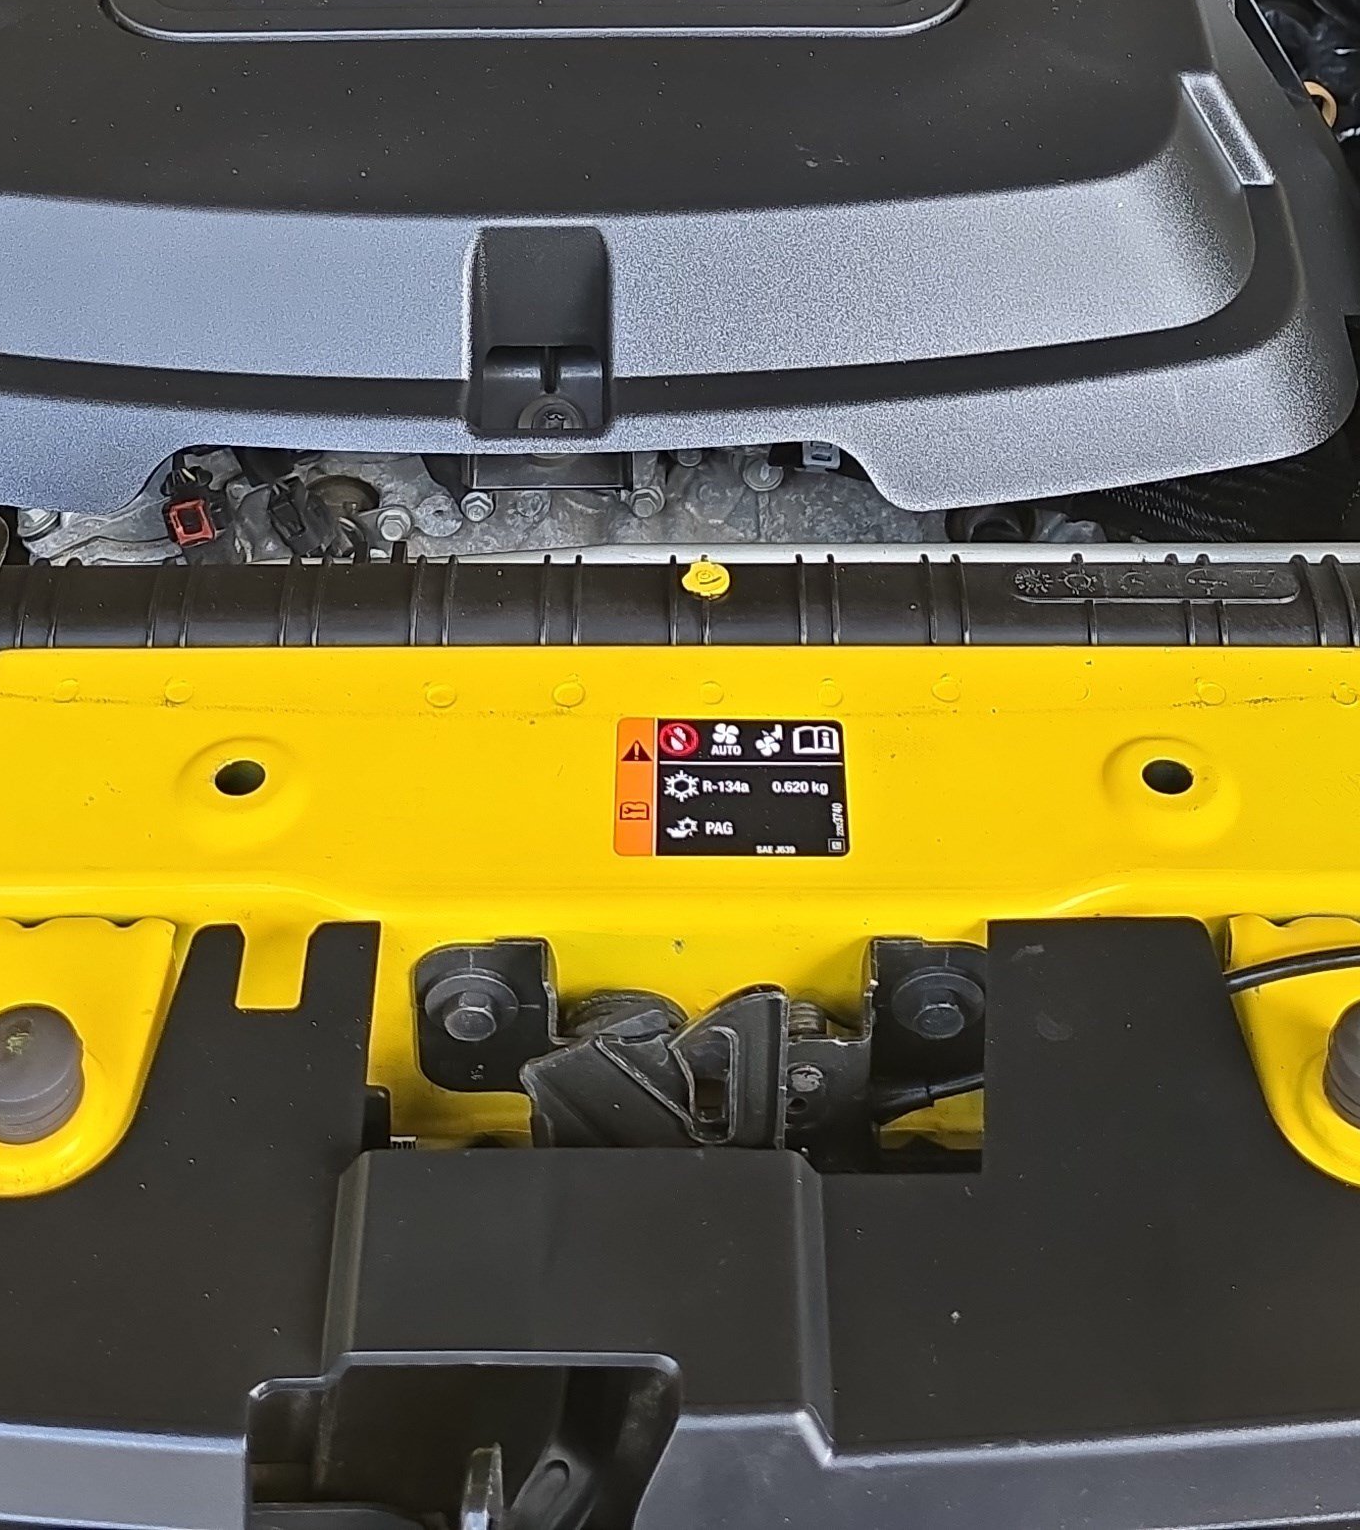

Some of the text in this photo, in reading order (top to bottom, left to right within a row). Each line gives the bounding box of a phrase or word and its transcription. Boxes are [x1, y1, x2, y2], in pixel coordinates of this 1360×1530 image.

[711, 744, 741, 756] AUTO
[702, 780, 829, 796] R-134a 0.620 kg
[705, 822, 734, 835] PAG
[756, 845, 796, 854] SAE J639
